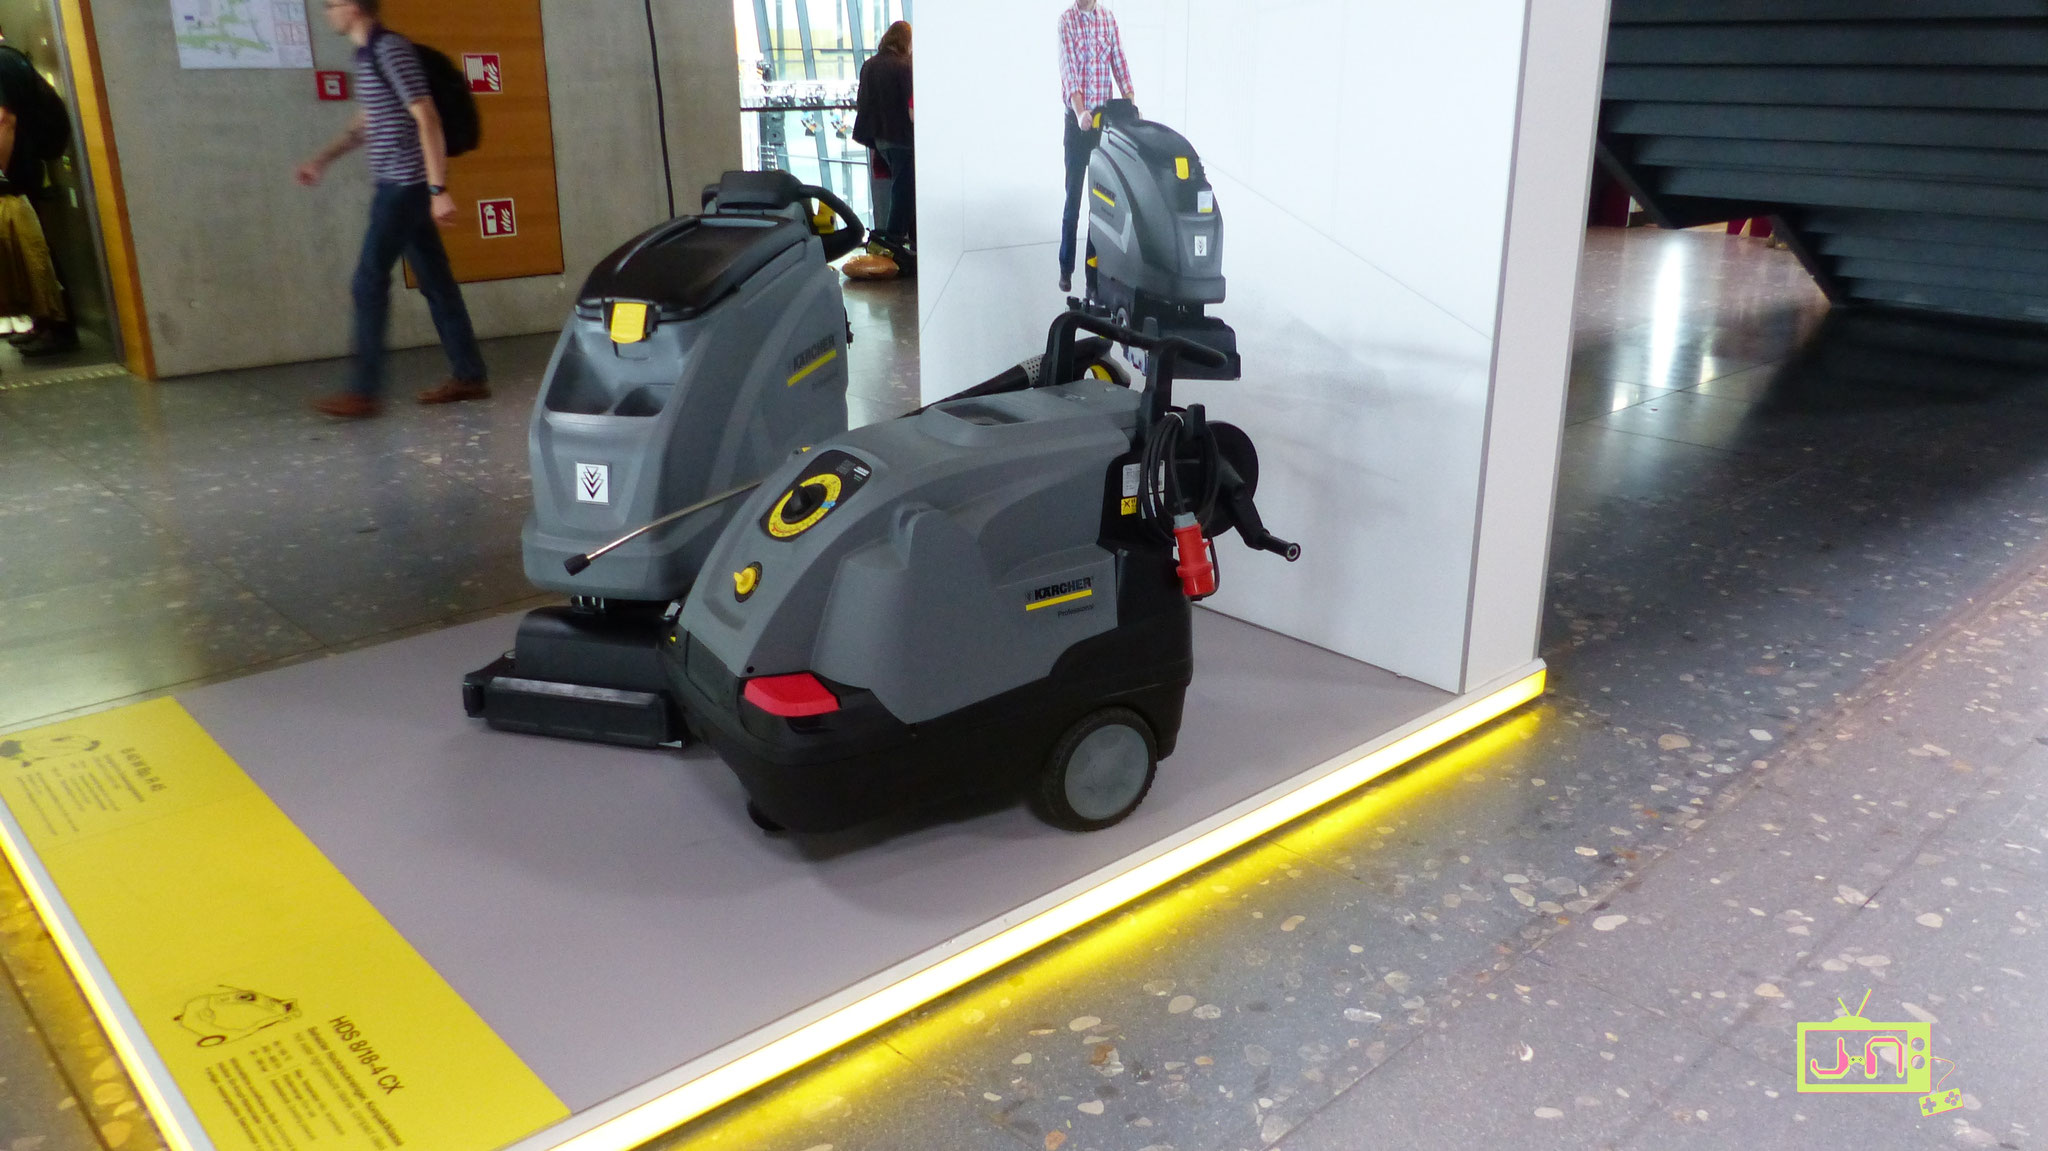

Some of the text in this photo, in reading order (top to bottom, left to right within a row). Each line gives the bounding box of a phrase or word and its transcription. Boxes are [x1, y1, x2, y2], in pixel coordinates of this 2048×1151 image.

[1034, 577, 1092, 601] KÄRCHER
[329, 1015, 405, 1095] HDS 8/18-4 CX
